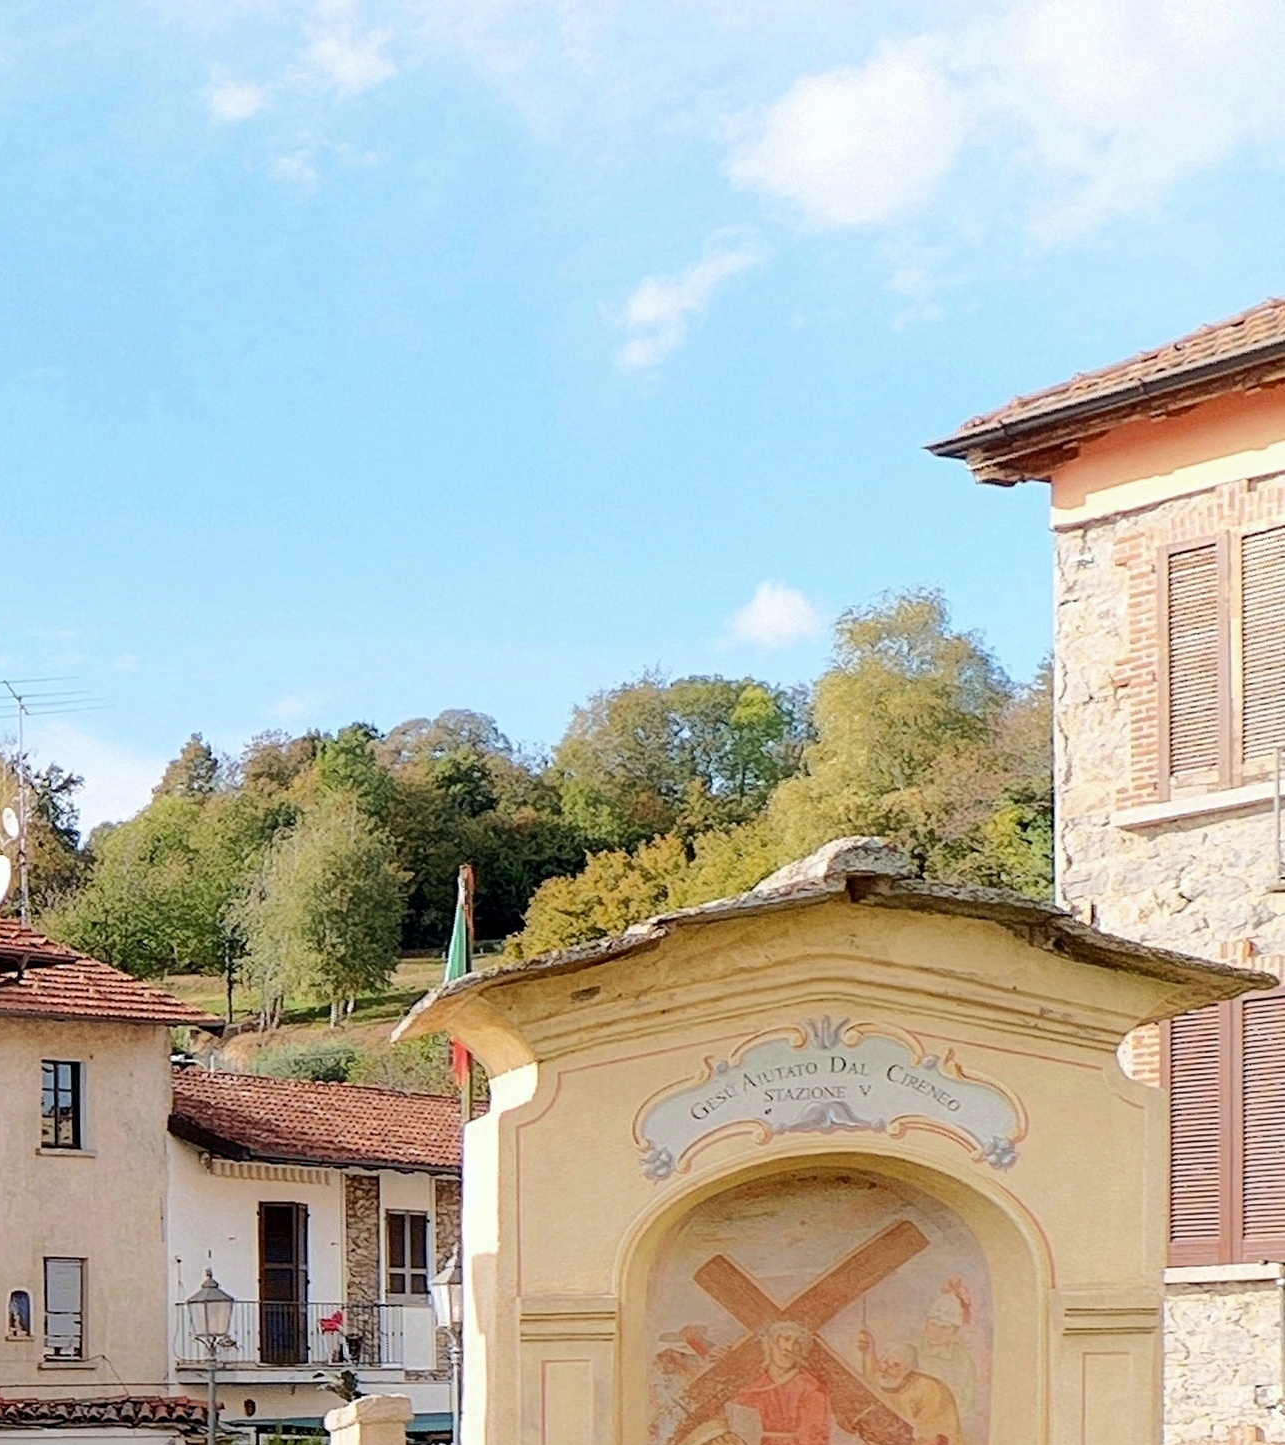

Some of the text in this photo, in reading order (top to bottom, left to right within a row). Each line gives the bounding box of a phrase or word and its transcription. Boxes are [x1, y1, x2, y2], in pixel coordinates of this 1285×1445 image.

[742, 1061, 818, 1092] AIUTATO
[830, 1055, 869, 1076] DAL
[886, 1063, 962, 1112] CIRENEO
[764, 1084, 871, 1102] STAZIONE V
